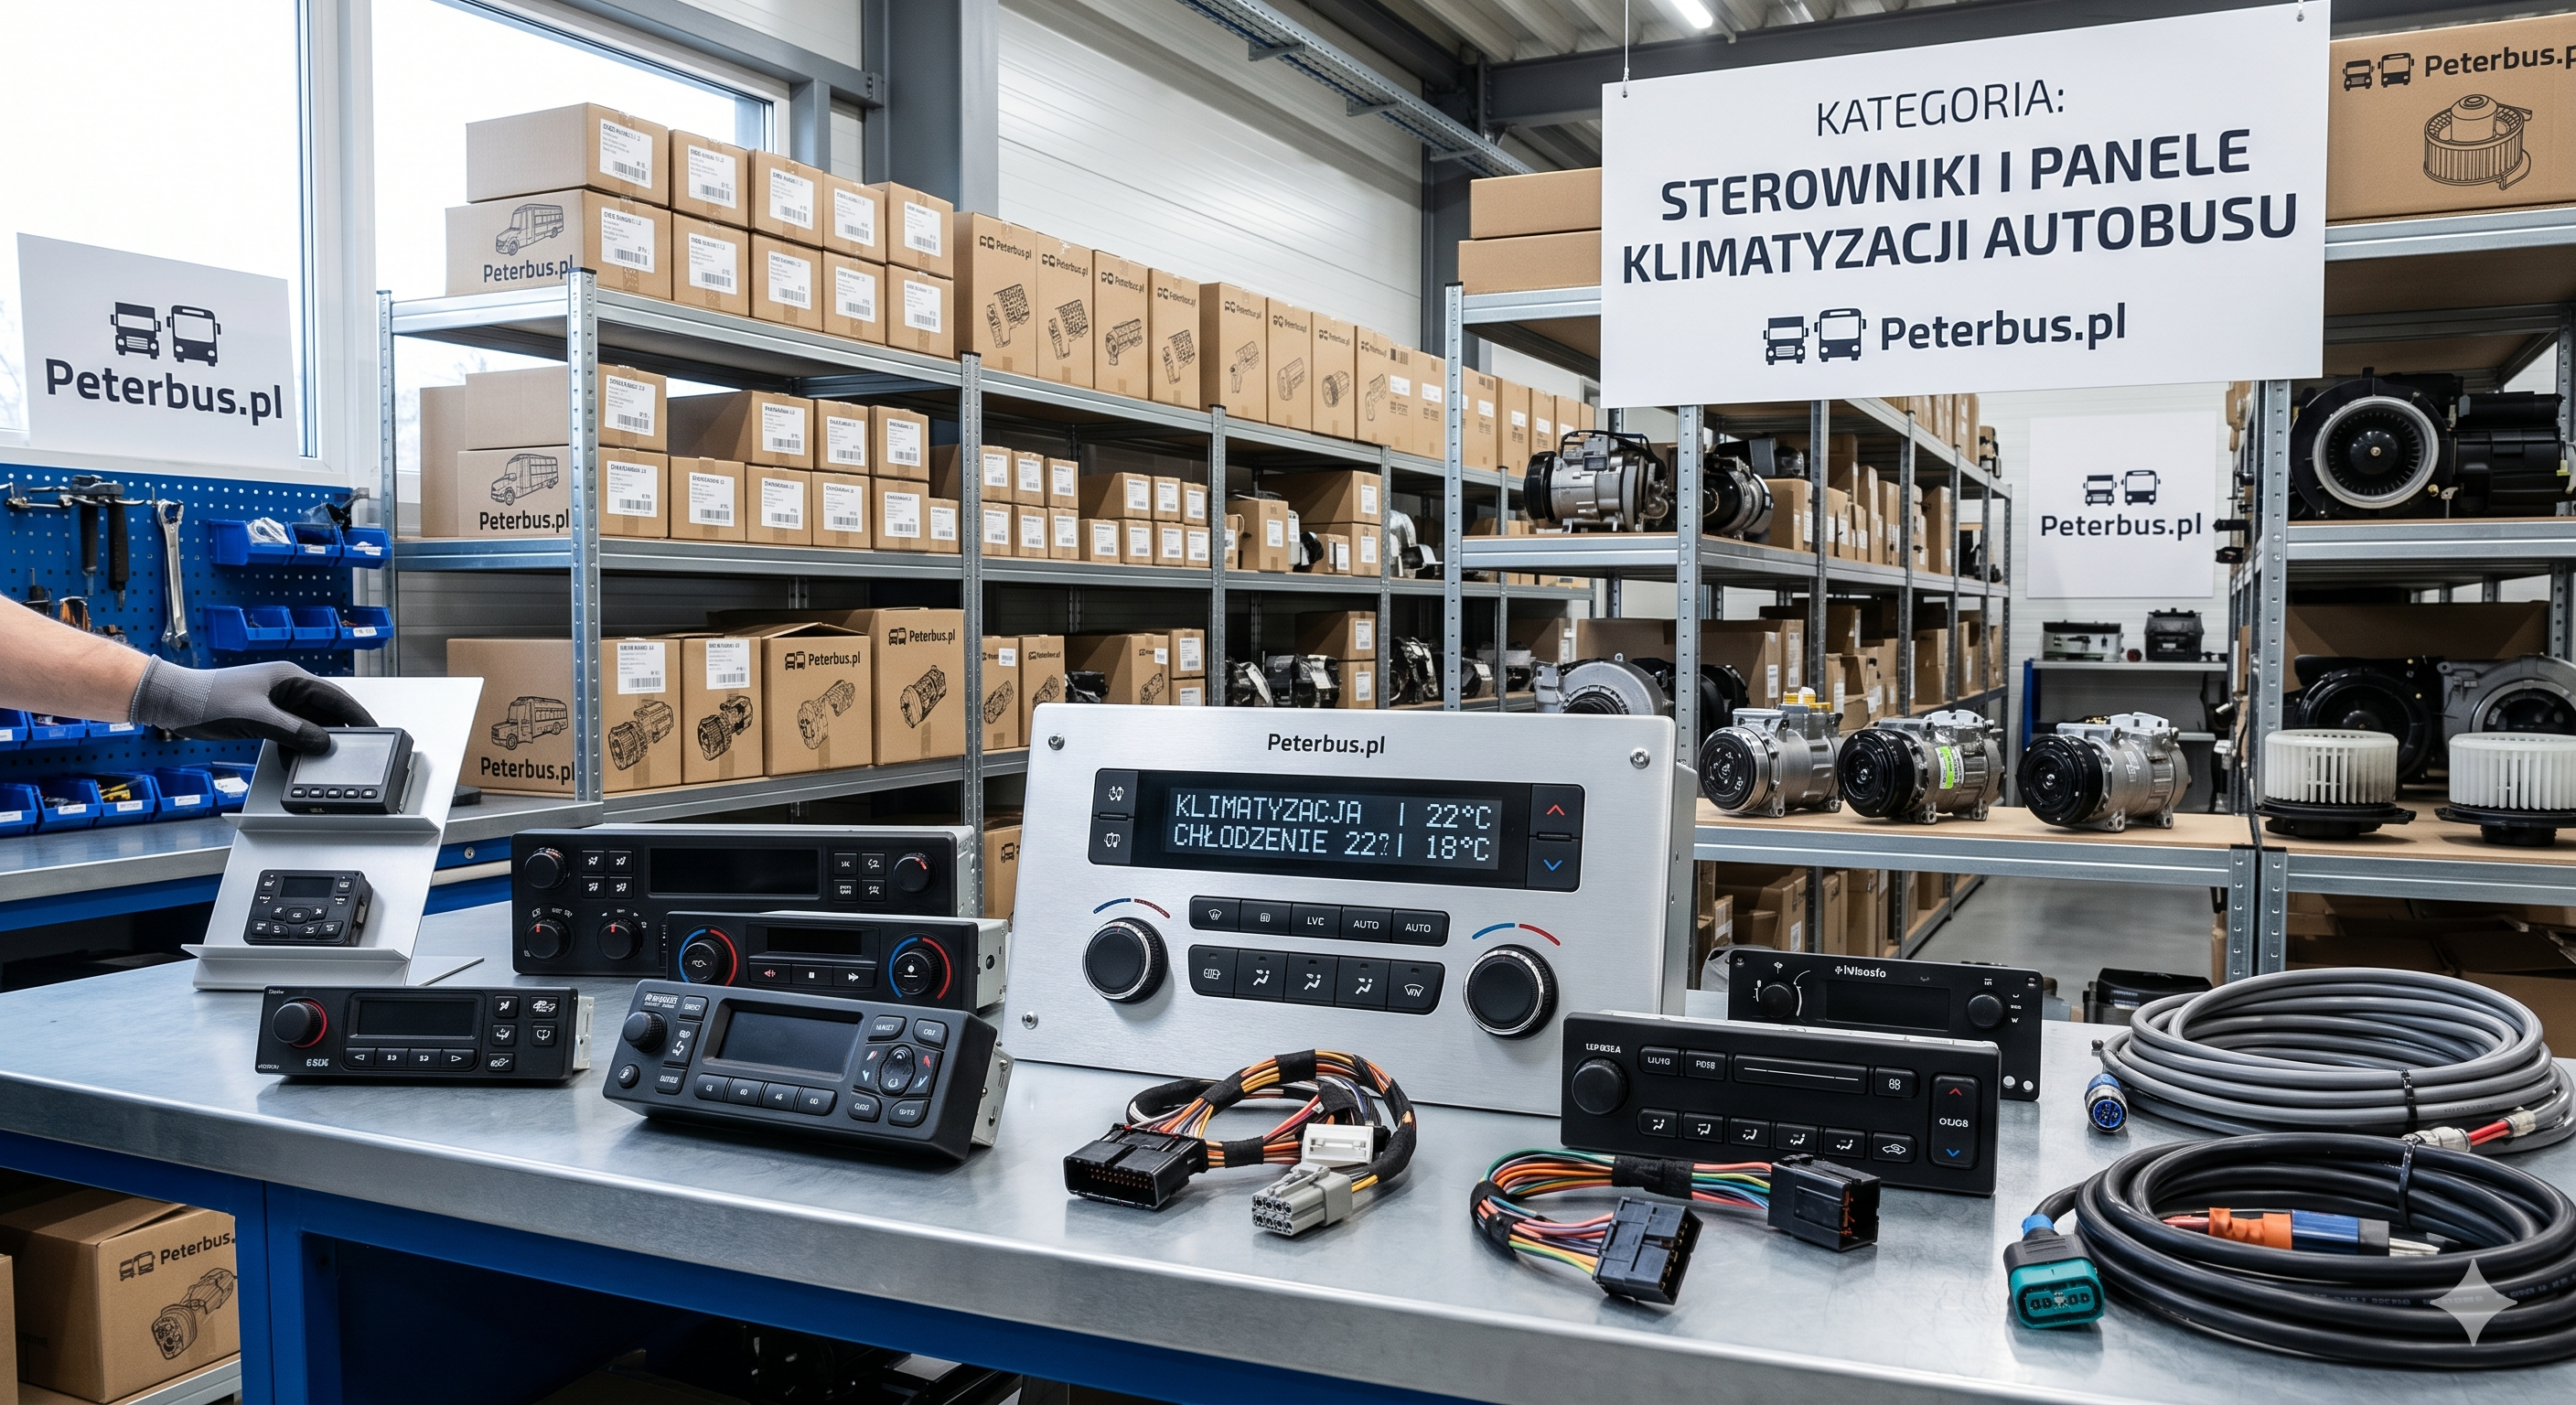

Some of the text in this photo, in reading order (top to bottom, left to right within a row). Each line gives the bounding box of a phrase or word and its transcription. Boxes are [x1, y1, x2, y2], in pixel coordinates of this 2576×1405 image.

[1817, 80, 2064, 136] KATEGORIA:
[1661, 129, 2250, 221] STEROWNIKI I PANELE
[1623, 193, 2297, 284] KLIMATYZACJI AUTOBUSU
[484, 255, 573, 283] Peterbus.pl
[1882, 303, 2126, 350] Peterbus.pl
[46, 358, 283, 426] Peterbus.pl
[479, 509, 569, 532] Peterbus.pl
[2041, 512, 2201, 542] Peterbus.pl
[908, 628, 956, 645] Peterbus.pl
[808, 650, 861, 667] Peterbus.pl
[1267, 733, 1386, 758] Peterbus.pl
[480, 756, 574, 785] Peterbus.pl
[1176, 794, 1362, 824] KLIMATYZACJA
[1426, 803, 1491, 830] 22°C
[1174, 823, 1327, 853] CHŁODZENIE
[1427, 834, 1488, 862] 18°C
[1307, 917, 1325, 926] LVC
[1353, 919, 1379, 929] AUTO
[1405, 923, 1431, 933] AUTO
